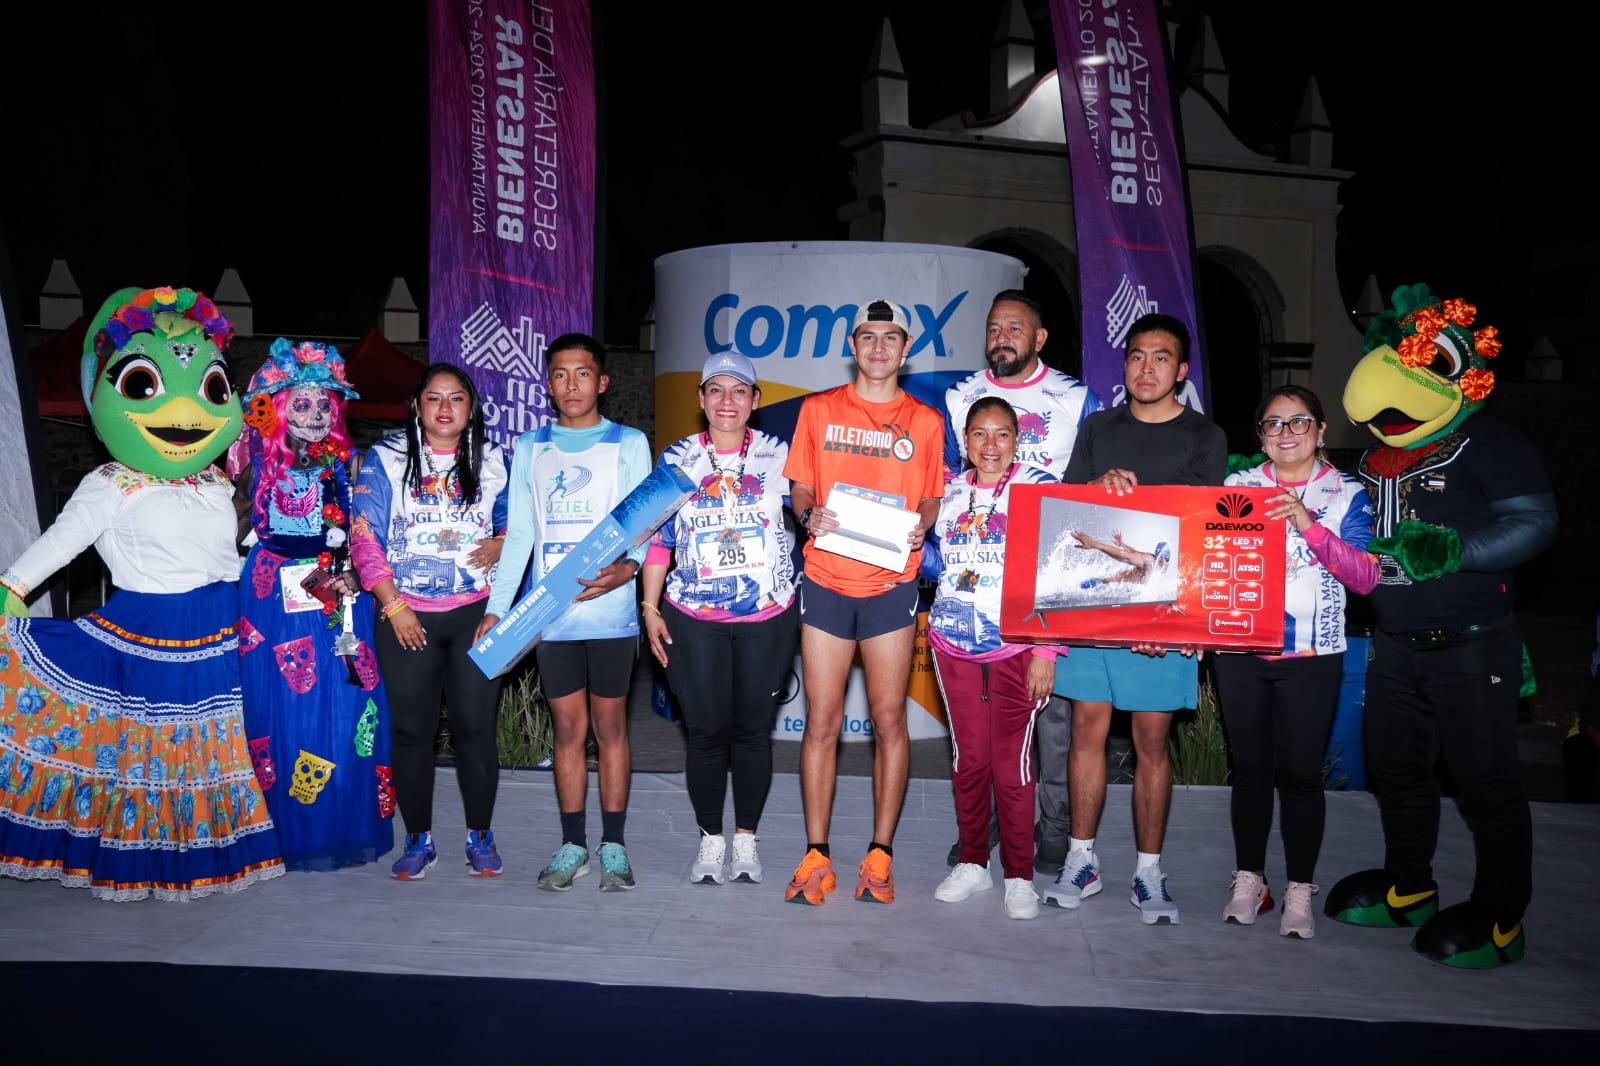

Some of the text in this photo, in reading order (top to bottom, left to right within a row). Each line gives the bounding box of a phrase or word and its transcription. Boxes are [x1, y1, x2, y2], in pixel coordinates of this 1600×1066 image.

[825, 424, 893, 449] ATLETISMO
[823, 441, 890, 459] AZTECAS
[546, 500, 594, 514] UZIEL
[1205, 522, 1265, 532] DAEWOO
[416, 528, 479, 546] Coex
[1233, 538, 1250, 546] LED
[1253, 537, 1264, 546] TV
[718, 546, 746, 567] 295
[1210, 561, 1224, 569] HD
[1318, 566, 1332, 648] SANTA MARÍ
[495, 611, 520, 636] SONIDO
